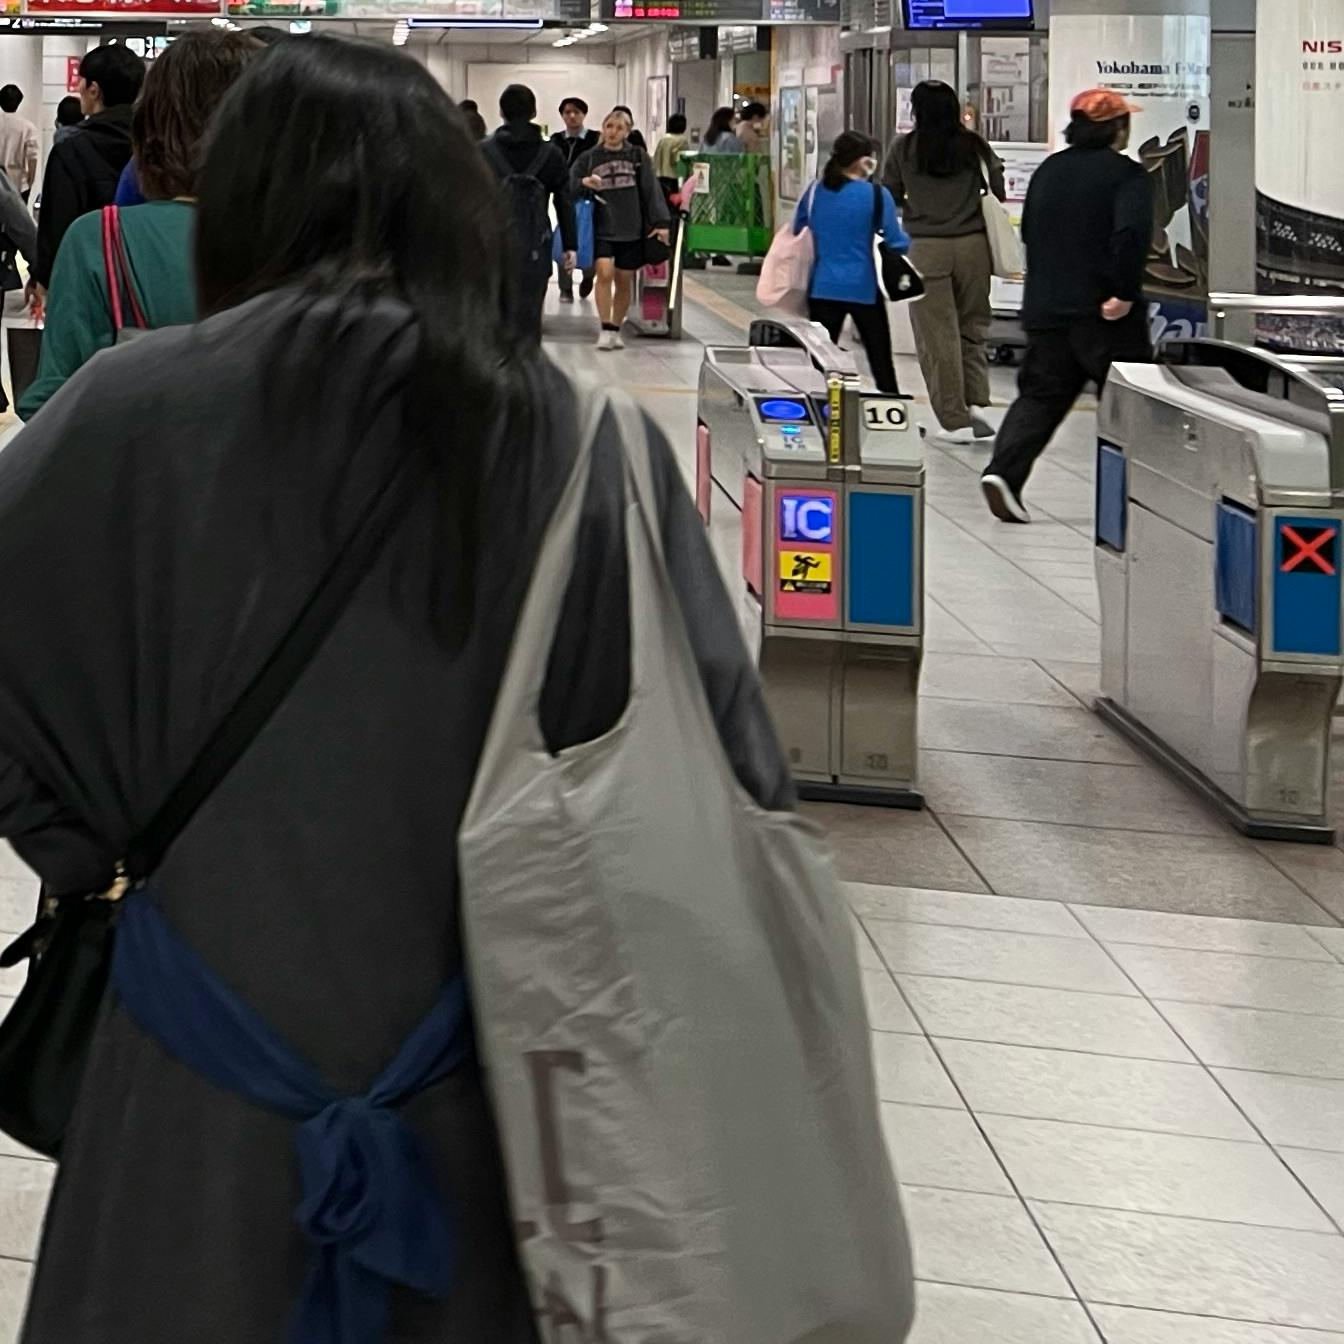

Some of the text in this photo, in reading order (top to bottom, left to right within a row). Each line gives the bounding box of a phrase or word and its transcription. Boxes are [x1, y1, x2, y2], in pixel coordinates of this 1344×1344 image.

[1302, 40, 1343, 53] NIS
[1096, 60, 1170, 75] Yokohama
[866, 407, 906, 425] 10
[782, 498, 833, 540] IC
